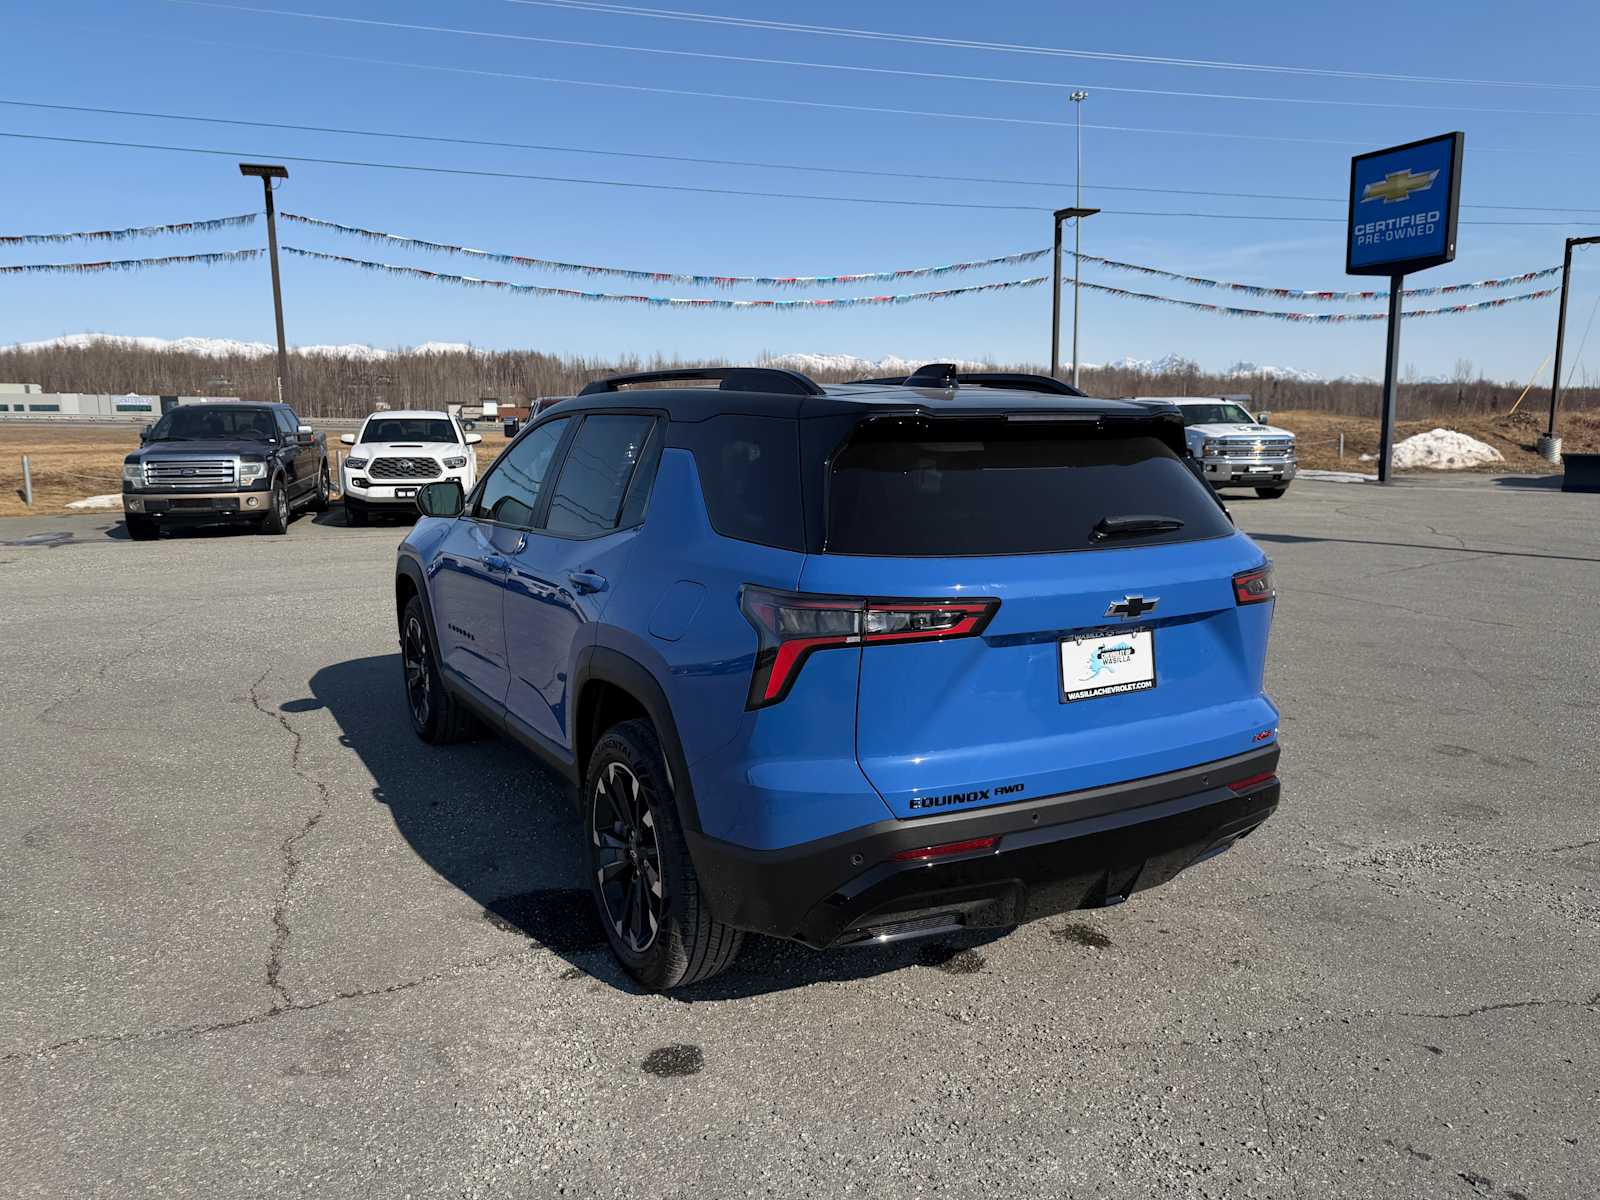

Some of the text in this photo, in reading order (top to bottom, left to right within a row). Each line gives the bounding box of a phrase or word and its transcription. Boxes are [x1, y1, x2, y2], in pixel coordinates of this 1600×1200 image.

[1354, 210, 1440, 236] CERTIFIED
[1357, 223, 1435, 246] PRE-OWNED
[1102, 655, 1131, 665] WASILLA
[1067, 680, 1152, 700] WASILLACHEVROLET.COM
[909, 783, 1025, 809] EQUINOX AWD
